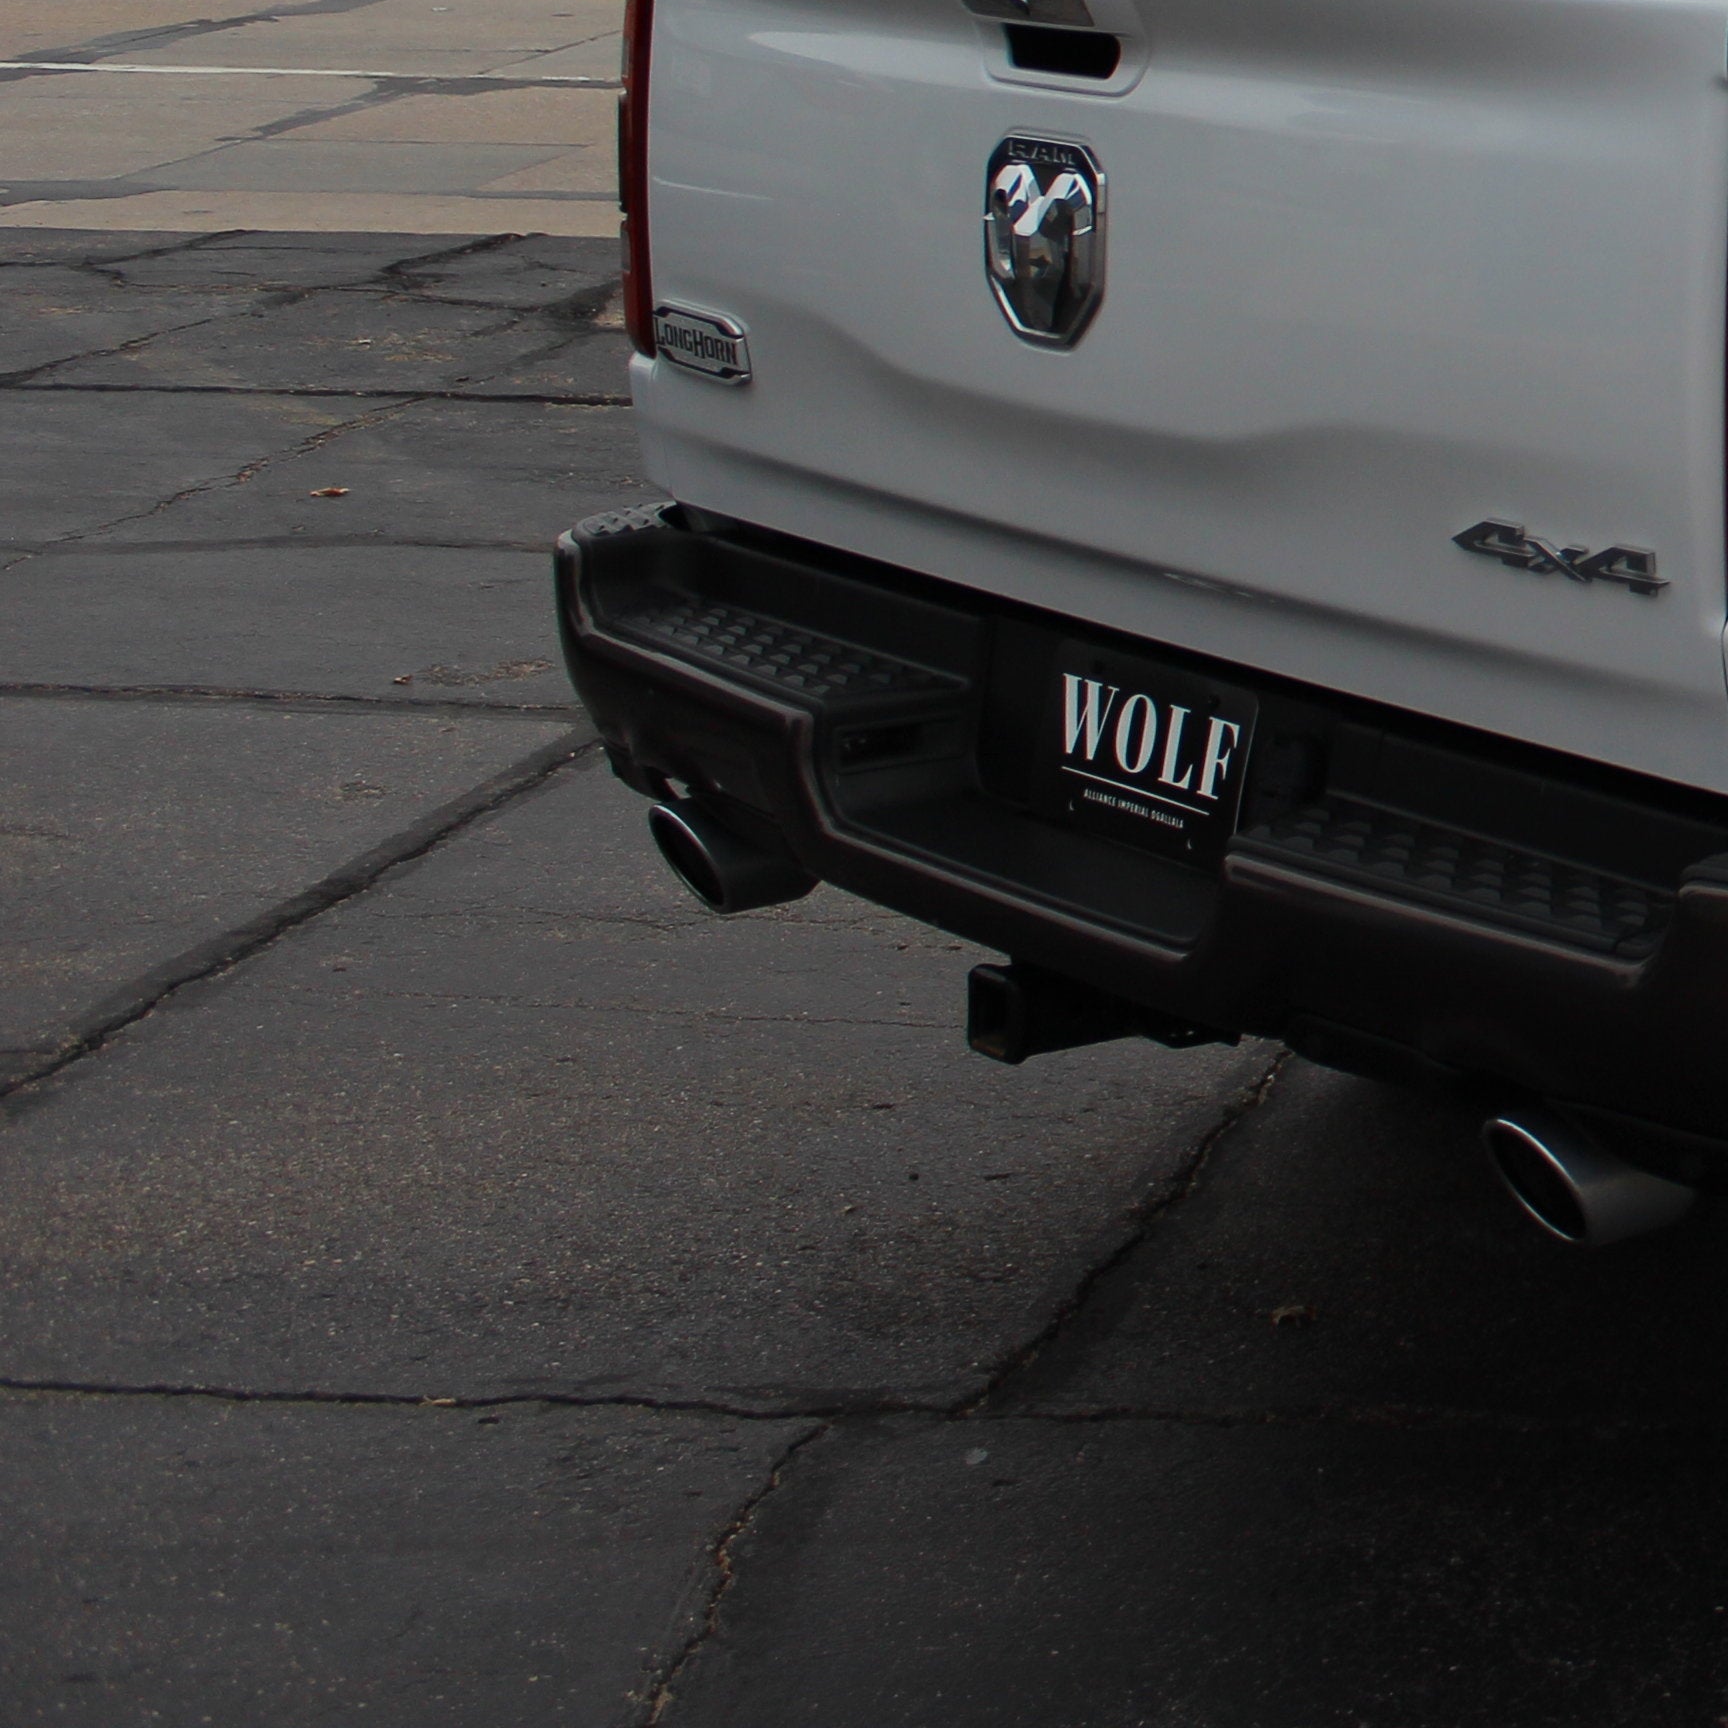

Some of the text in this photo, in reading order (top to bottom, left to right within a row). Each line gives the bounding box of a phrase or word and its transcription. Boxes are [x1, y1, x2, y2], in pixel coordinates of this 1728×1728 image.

[1007, 140, 1076, 166] RAM
[1062, 672, 1241, 800] WOLF
[1083, 788, 1117, 806] ALLIANCE
[1118, 800, 1149, 817] IMPERIAL
